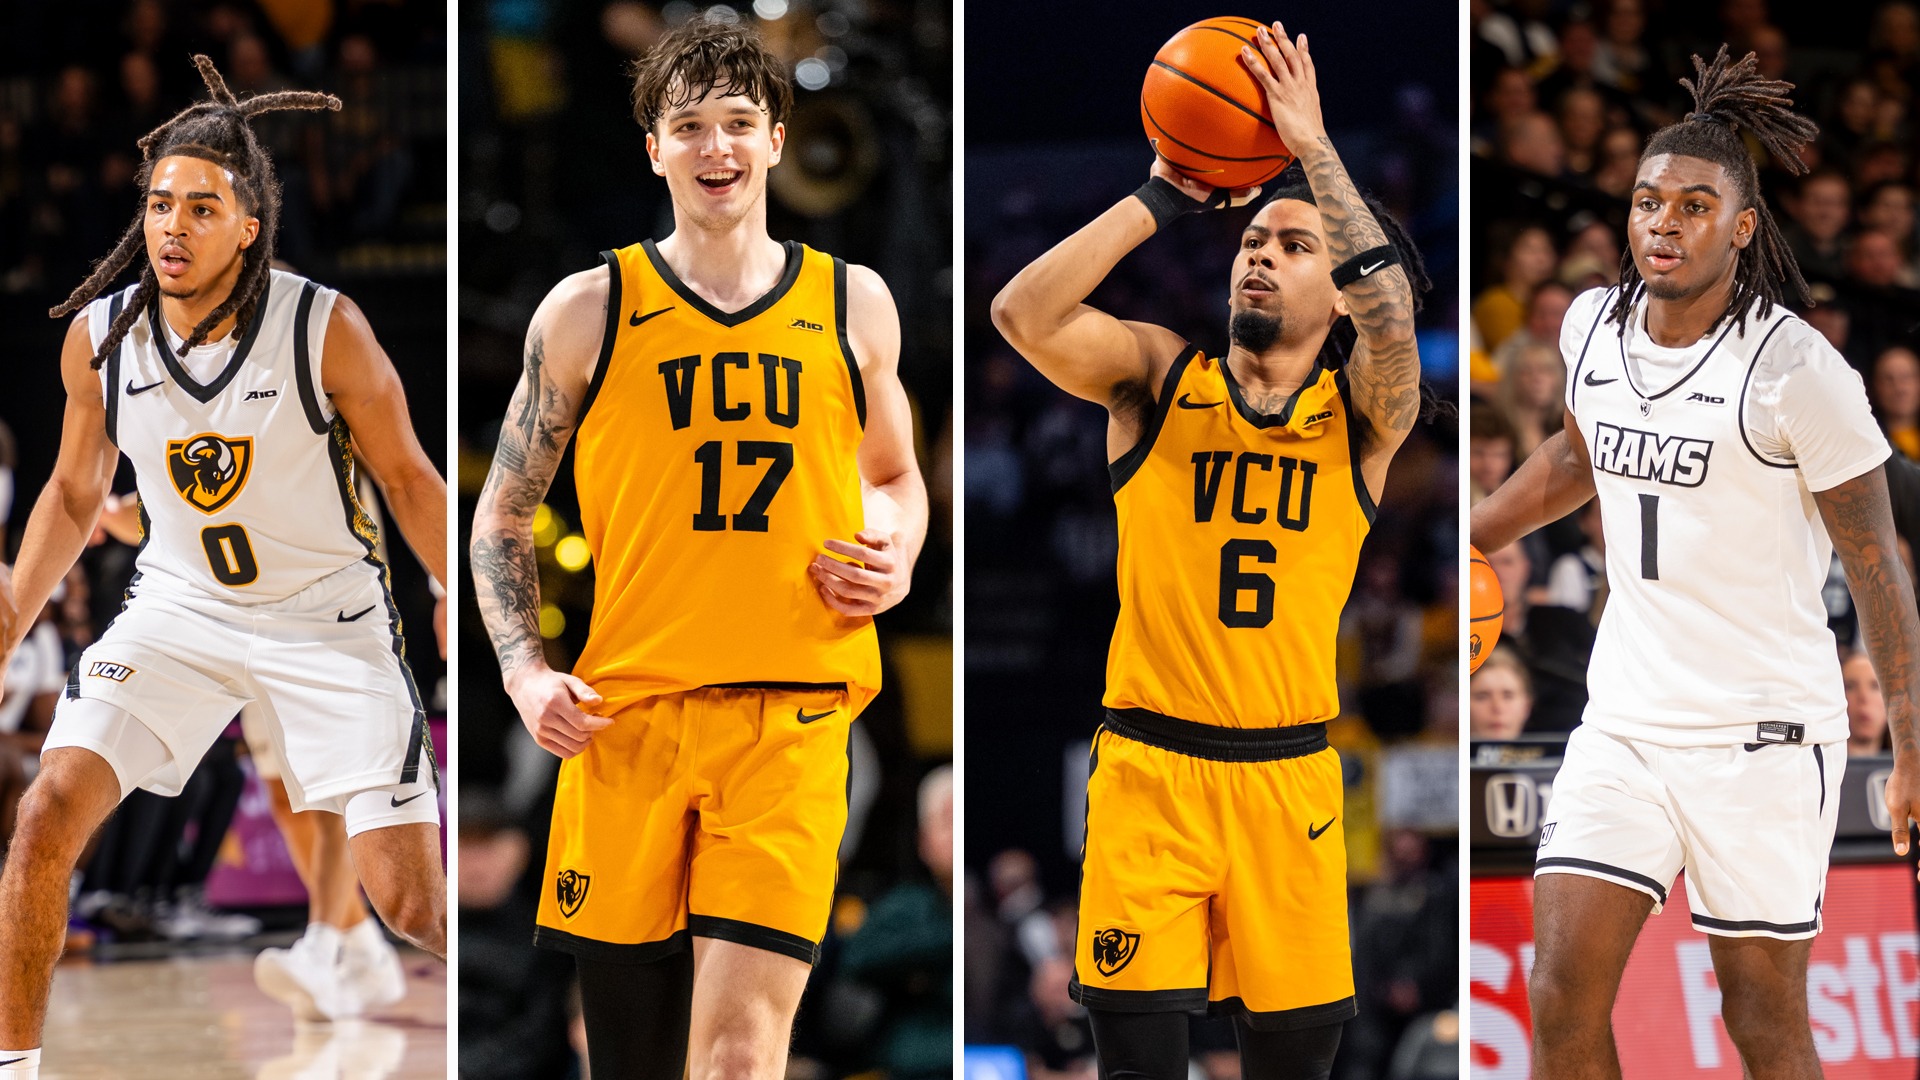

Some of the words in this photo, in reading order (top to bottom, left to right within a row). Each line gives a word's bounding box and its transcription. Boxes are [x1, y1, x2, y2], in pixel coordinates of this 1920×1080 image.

[658, 352, 802, 431] VCU
[693, 440, 794, 532] 17
[1191, 451, 1317, 532] VCU
[1594, 421, 1714, 488] RAMS
[199, 521, 261, 588] 0
[1638, 493, 1660, 580] 1
[1218, 538, 1277, 628] 6
[88, 661, 136, 683] VCU
[1791, 729, 1798, 739] L
